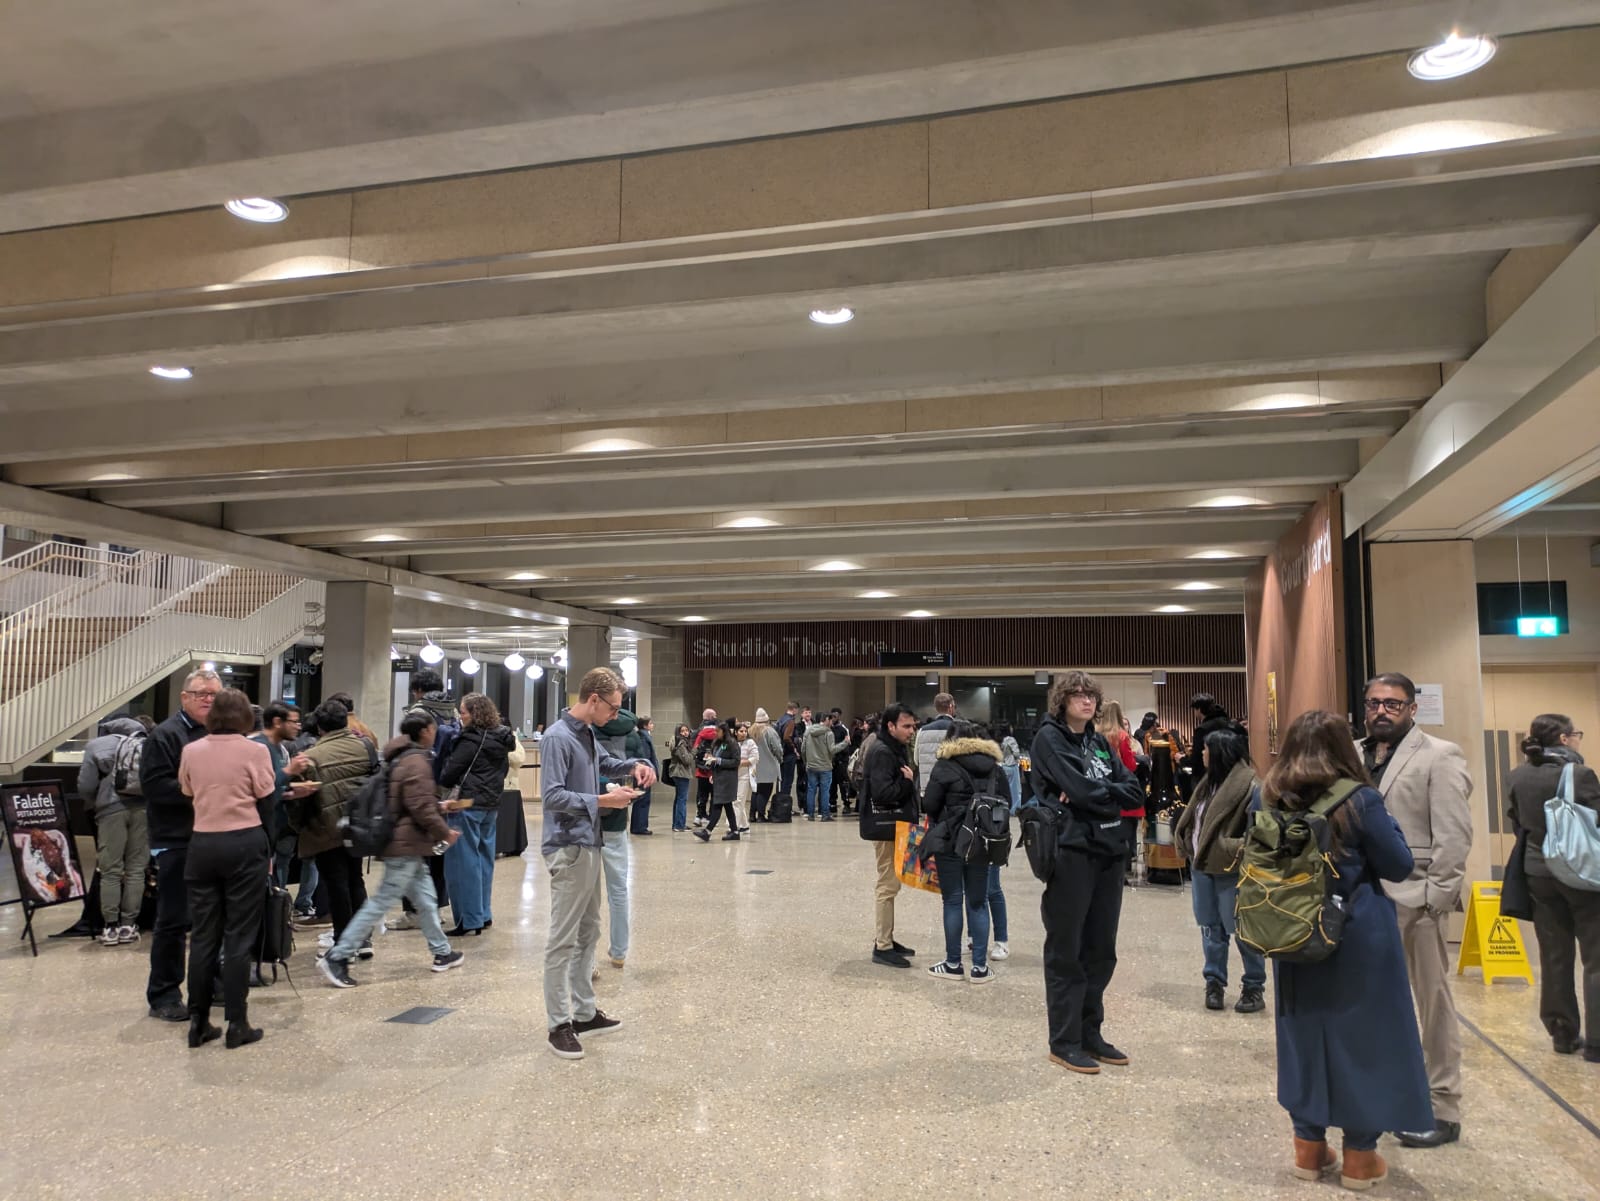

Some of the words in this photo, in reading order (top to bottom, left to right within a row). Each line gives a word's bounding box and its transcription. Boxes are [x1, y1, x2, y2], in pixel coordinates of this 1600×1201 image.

[1281, 519, 1331, 595] Courtyard
[693, 637, 778, 657] Studio
[782, 636, 888, 657] Theatre
[12, 792, 55, 809] Falafel
